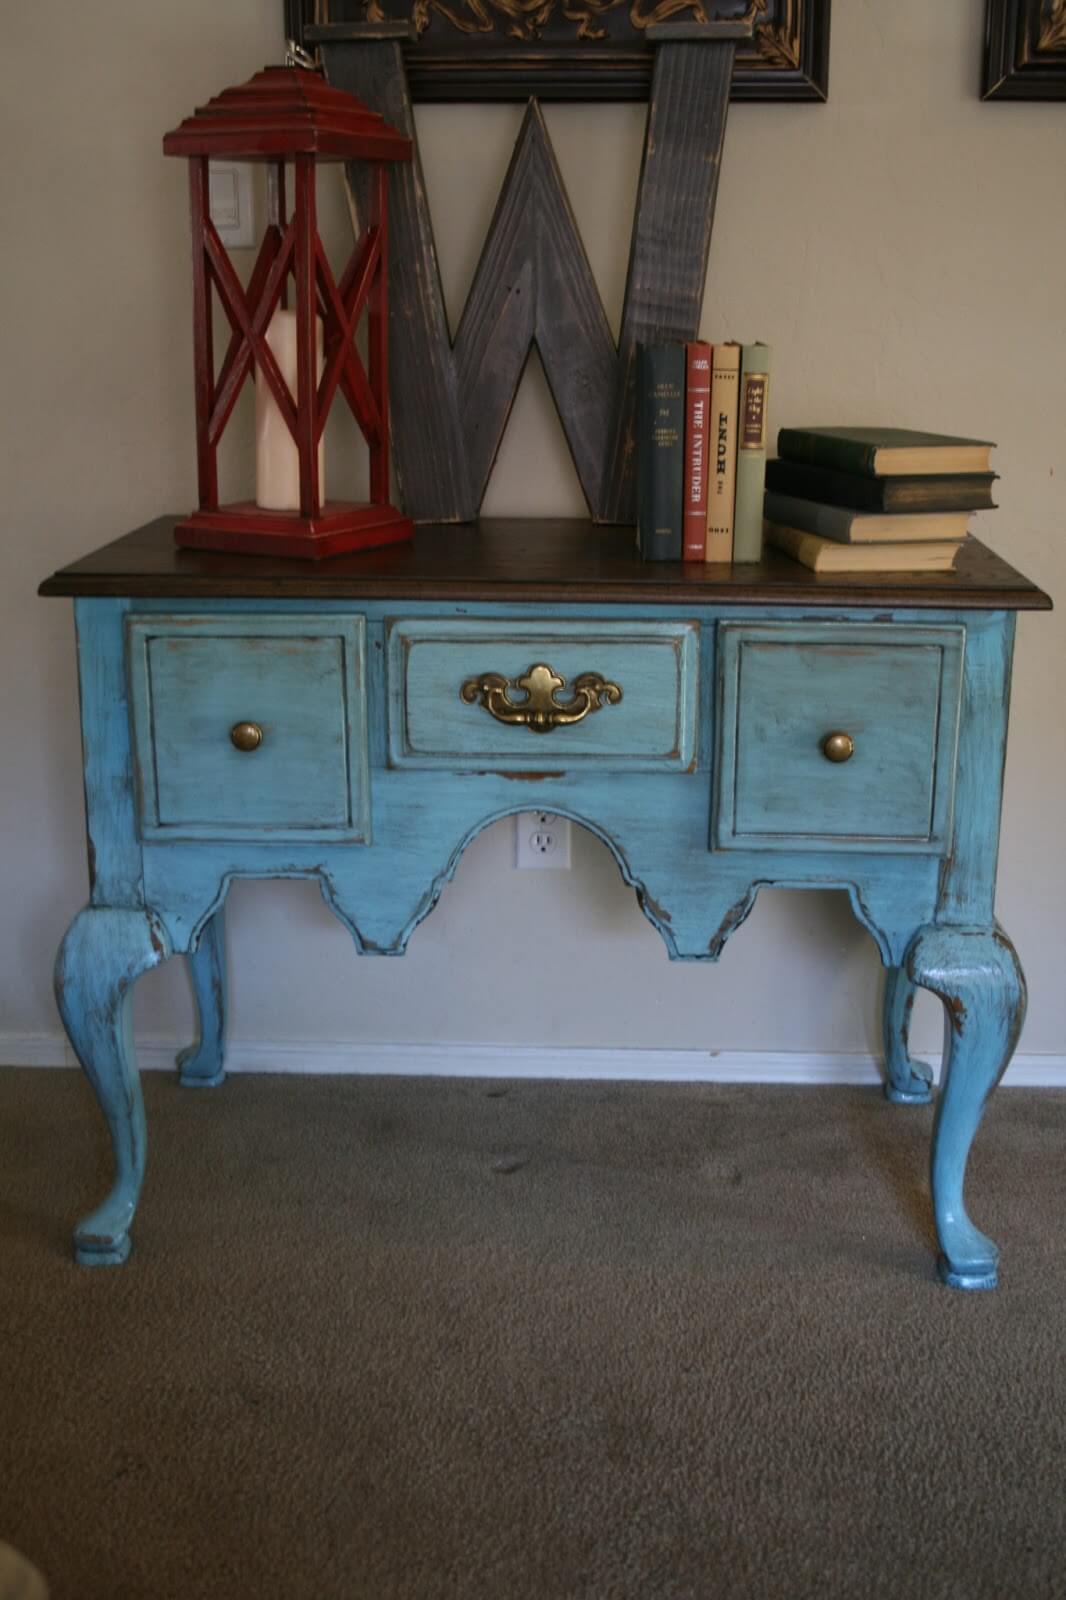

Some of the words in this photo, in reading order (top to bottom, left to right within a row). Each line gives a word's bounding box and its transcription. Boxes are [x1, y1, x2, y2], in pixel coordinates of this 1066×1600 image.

[692, 400, 705, 430] THE
[716, 412, 728, 475] HUNT
[691, 433, 704, 503] INTRUDER
